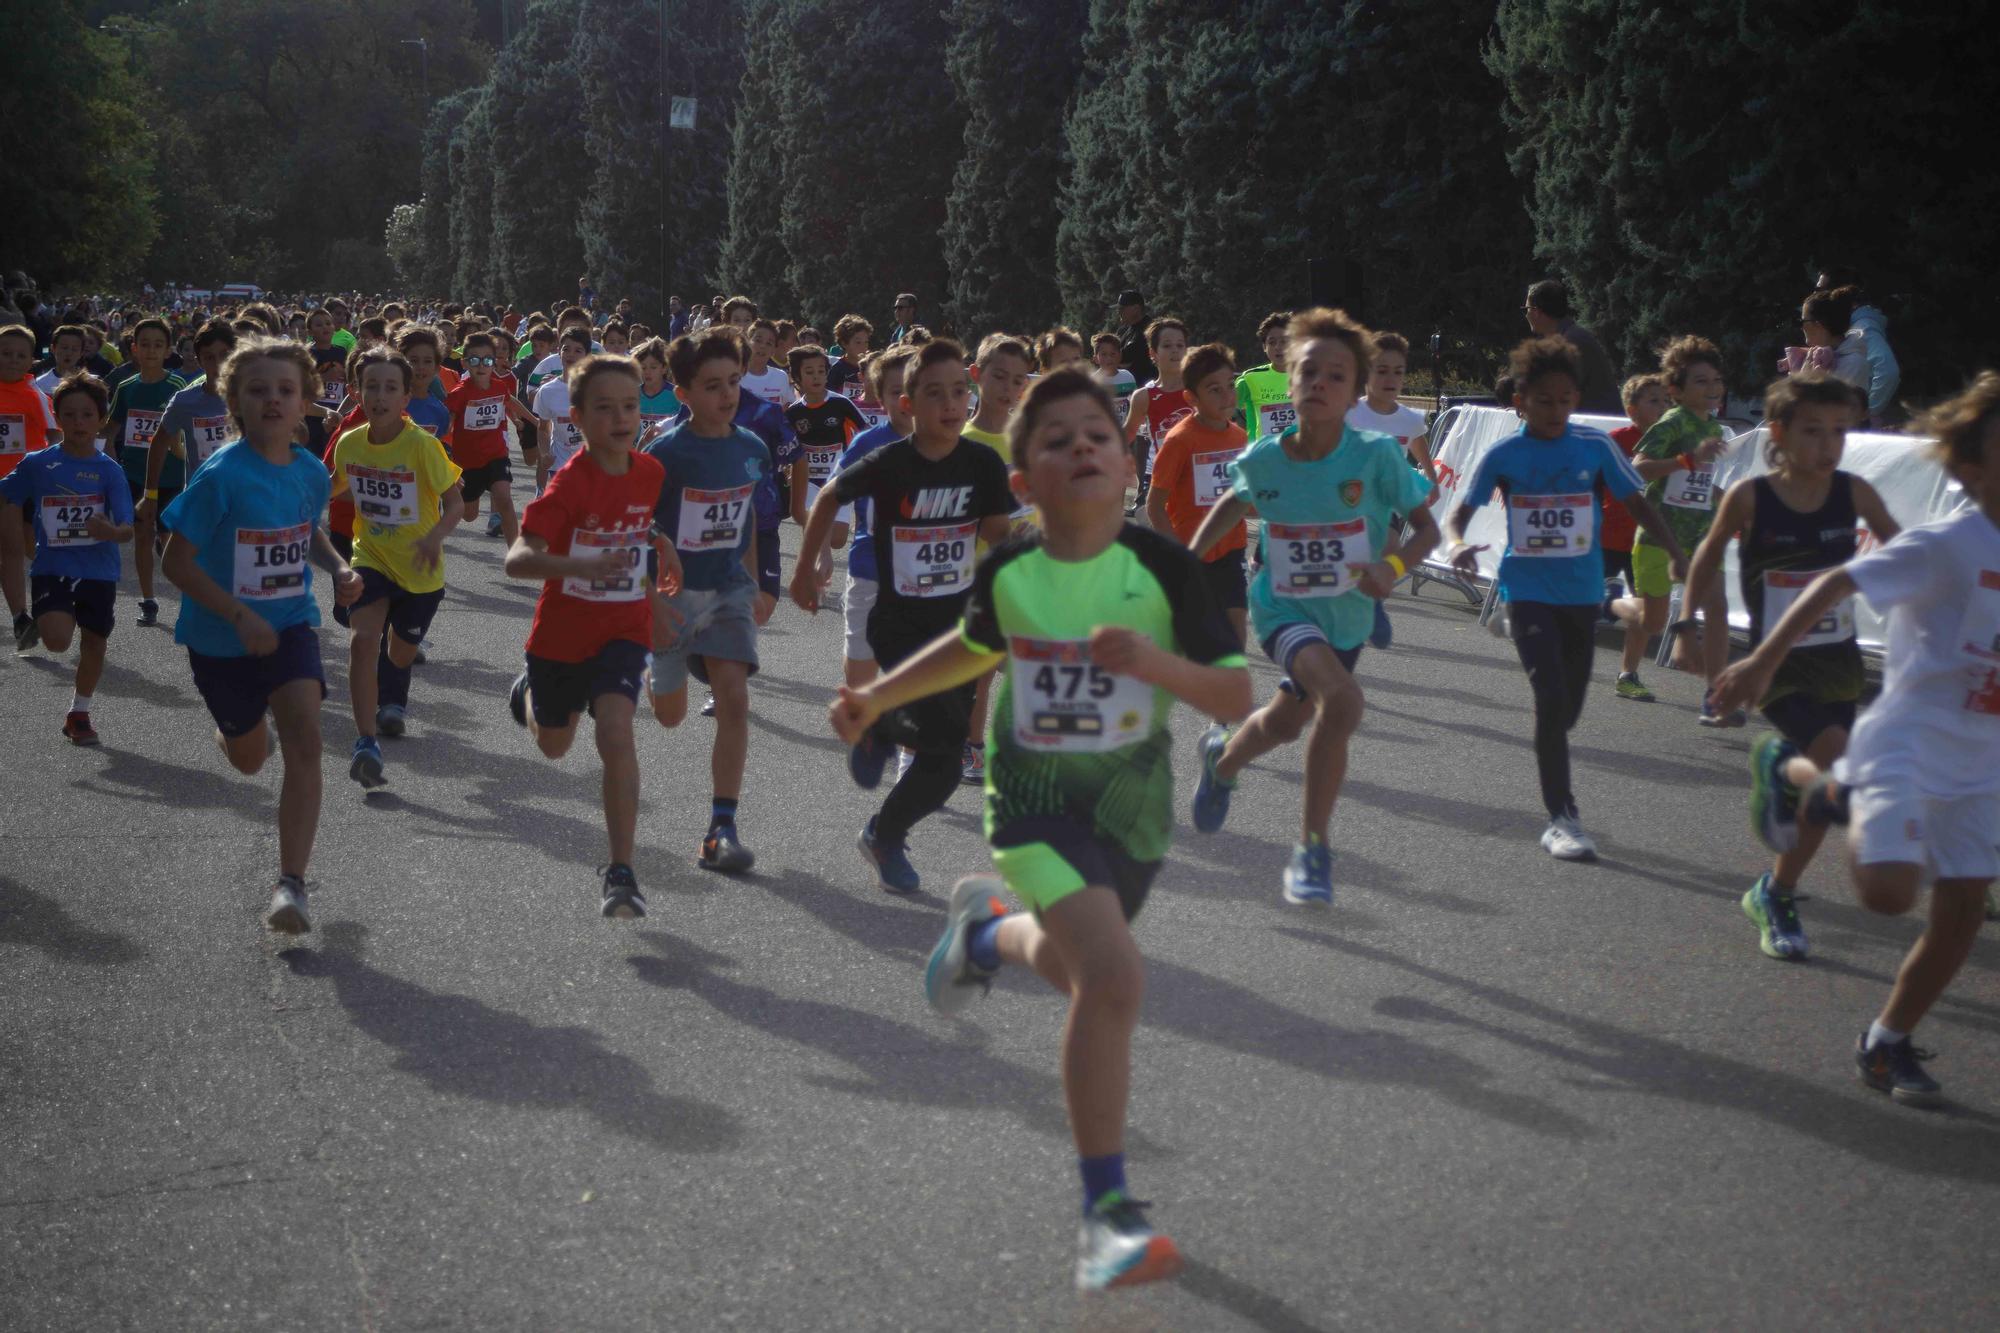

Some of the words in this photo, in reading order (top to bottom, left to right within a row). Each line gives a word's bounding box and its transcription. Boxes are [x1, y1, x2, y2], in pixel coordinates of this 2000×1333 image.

[476, 404, 498, 416] 403
[1270, 409, 1296, 422] 453
[356, 477, 403, 500] 1593
[56, 506, 94, 523] 422
[703, 500, 743, 523] 417
[911, 486, 974, 520] NIKE
[1526, 508, 1574, 528] 406
[916, 540, 965, 565] 480
[1288, 539, 1345, 564] 383
[930, 564, 953, 572] DIEGO
[1033, 664, 1115, 699] 475
